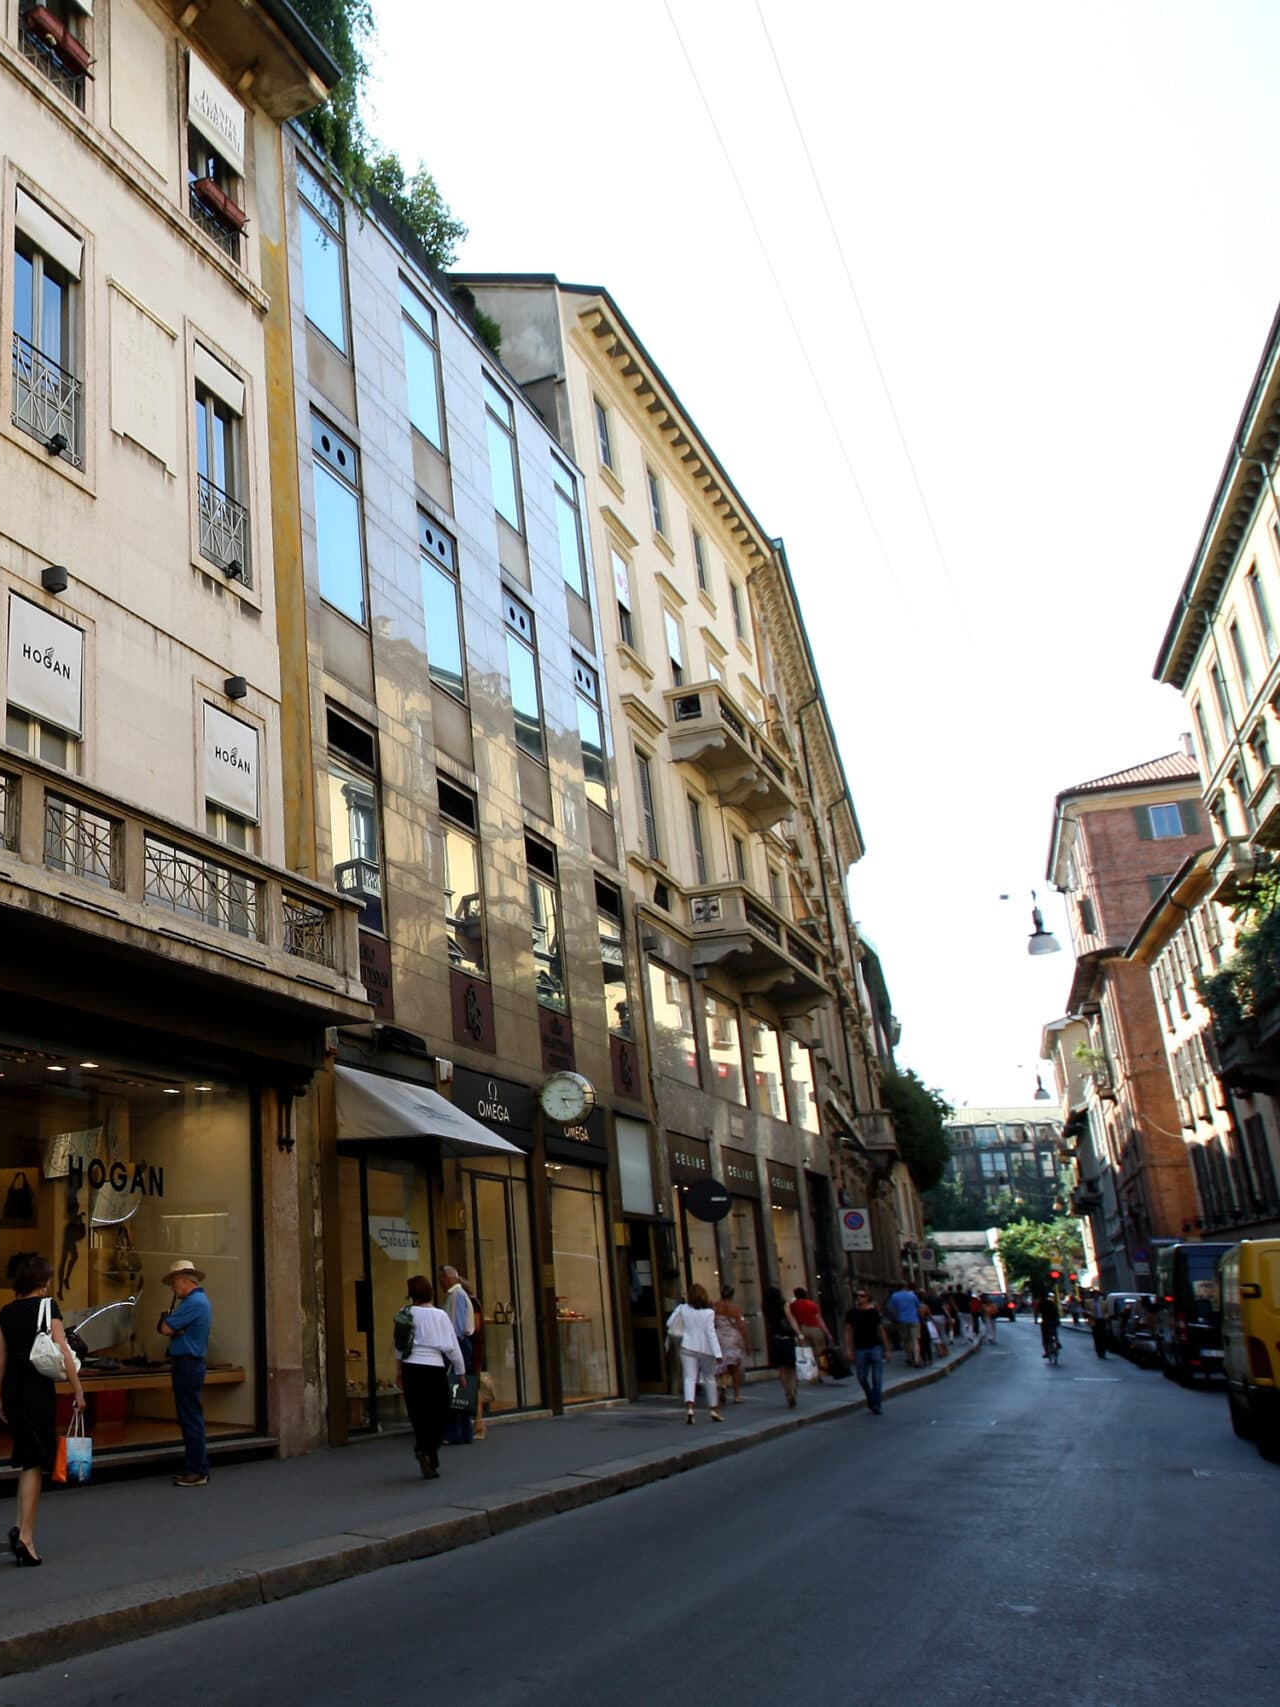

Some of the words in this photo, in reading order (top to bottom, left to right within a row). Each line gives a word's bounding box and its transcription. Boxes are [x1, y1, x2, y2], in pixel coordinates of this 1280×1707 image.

[22, 643, 71, 680] HOGAN
[215, 745, 251, 775] HOGAN
[477, 1100, 511, 1124] OMEGA
[563, 1125, 591, 1145] OMEGA
[68, 1155, 164, 1197] HOGAN
